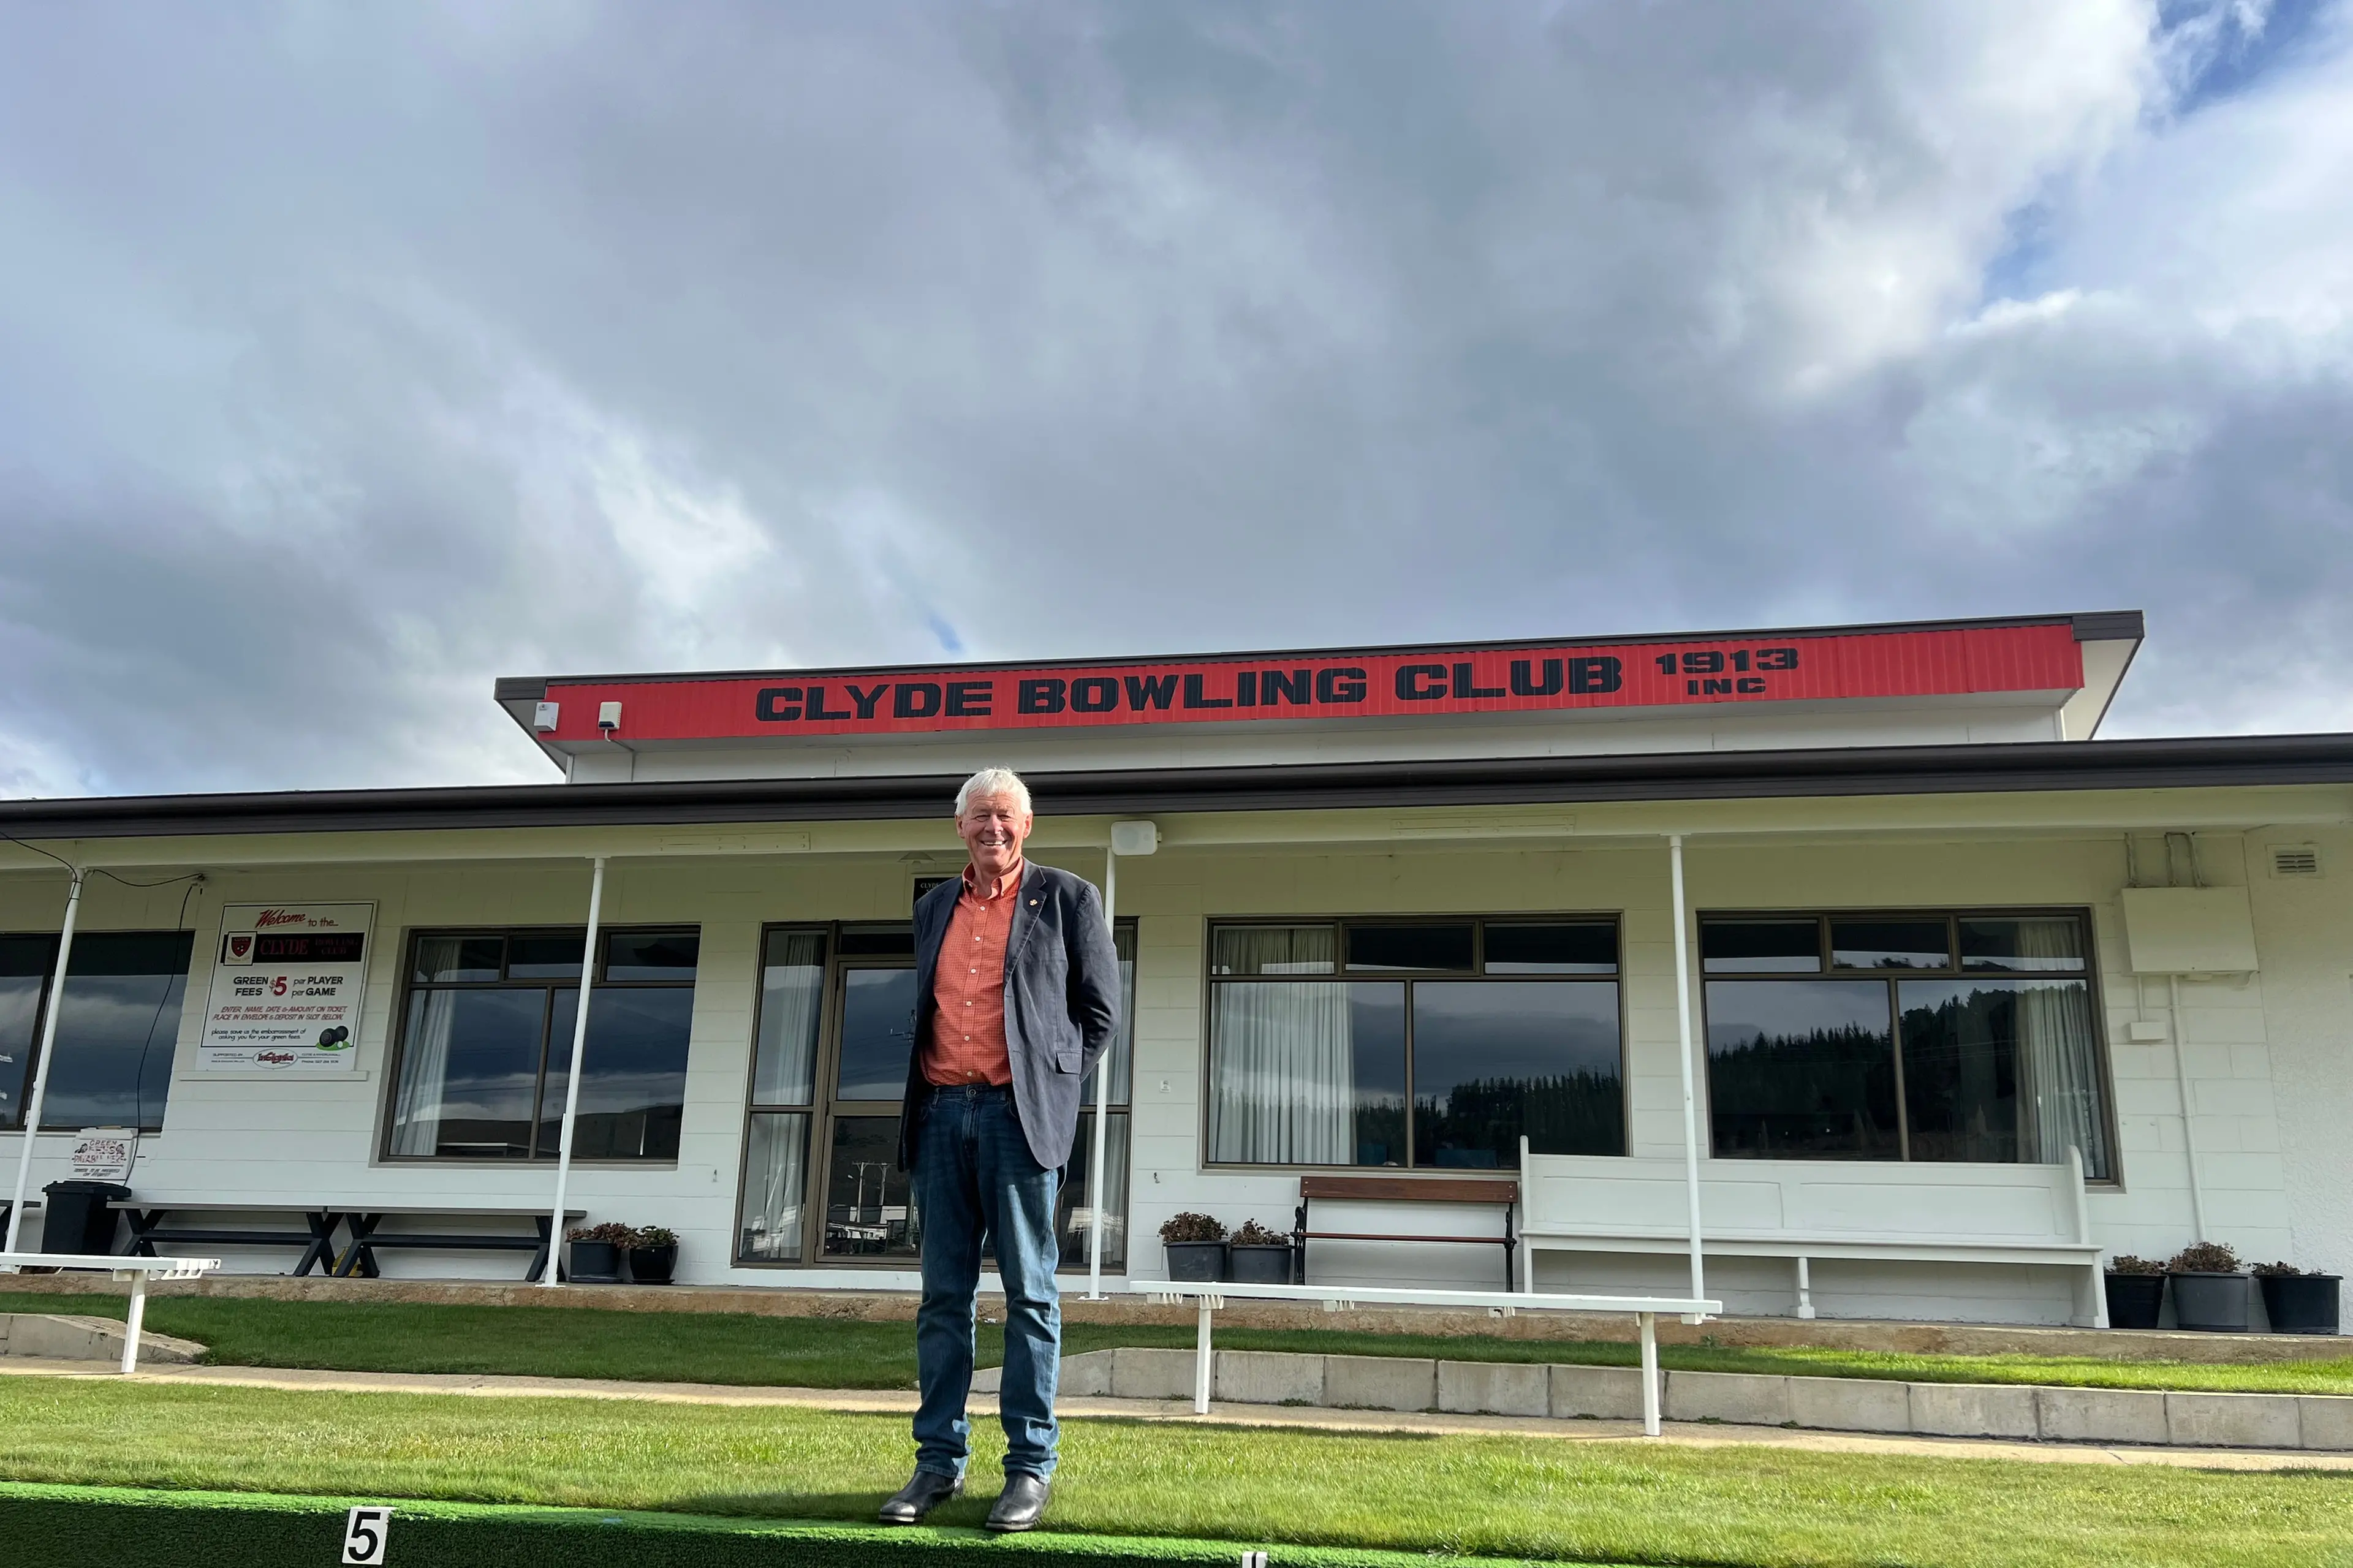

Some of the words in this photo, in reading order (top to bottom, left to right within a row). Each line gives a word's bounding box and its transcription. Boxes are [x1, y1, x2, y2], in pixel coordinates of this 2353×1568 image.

[756, 681, 993, 721] CLYDE
[1018, 667, 1367, 714] BOWLING
[1395, 656, 1622, 700] CLUB
[1656, 648, 1798, 675] 1913
[1688, 678, 1766, 695] INC
[255, 909, 306, 928] Welcome
[308, 918, 317, 927] to
[260, 939, 310, 955] CLYDE
[321, 947, 347, 955] CLUB
[233, 976, 269, 985] GREEN
[293, 978, 306, 987] per
[307, 976, 343, 985] PLAYER
[235, 988, 263, 996] FEES
[291, 990, 305, 999] per
[211, 1028, 229, 1036] please
[348, 1511, 381, 1561] 5
